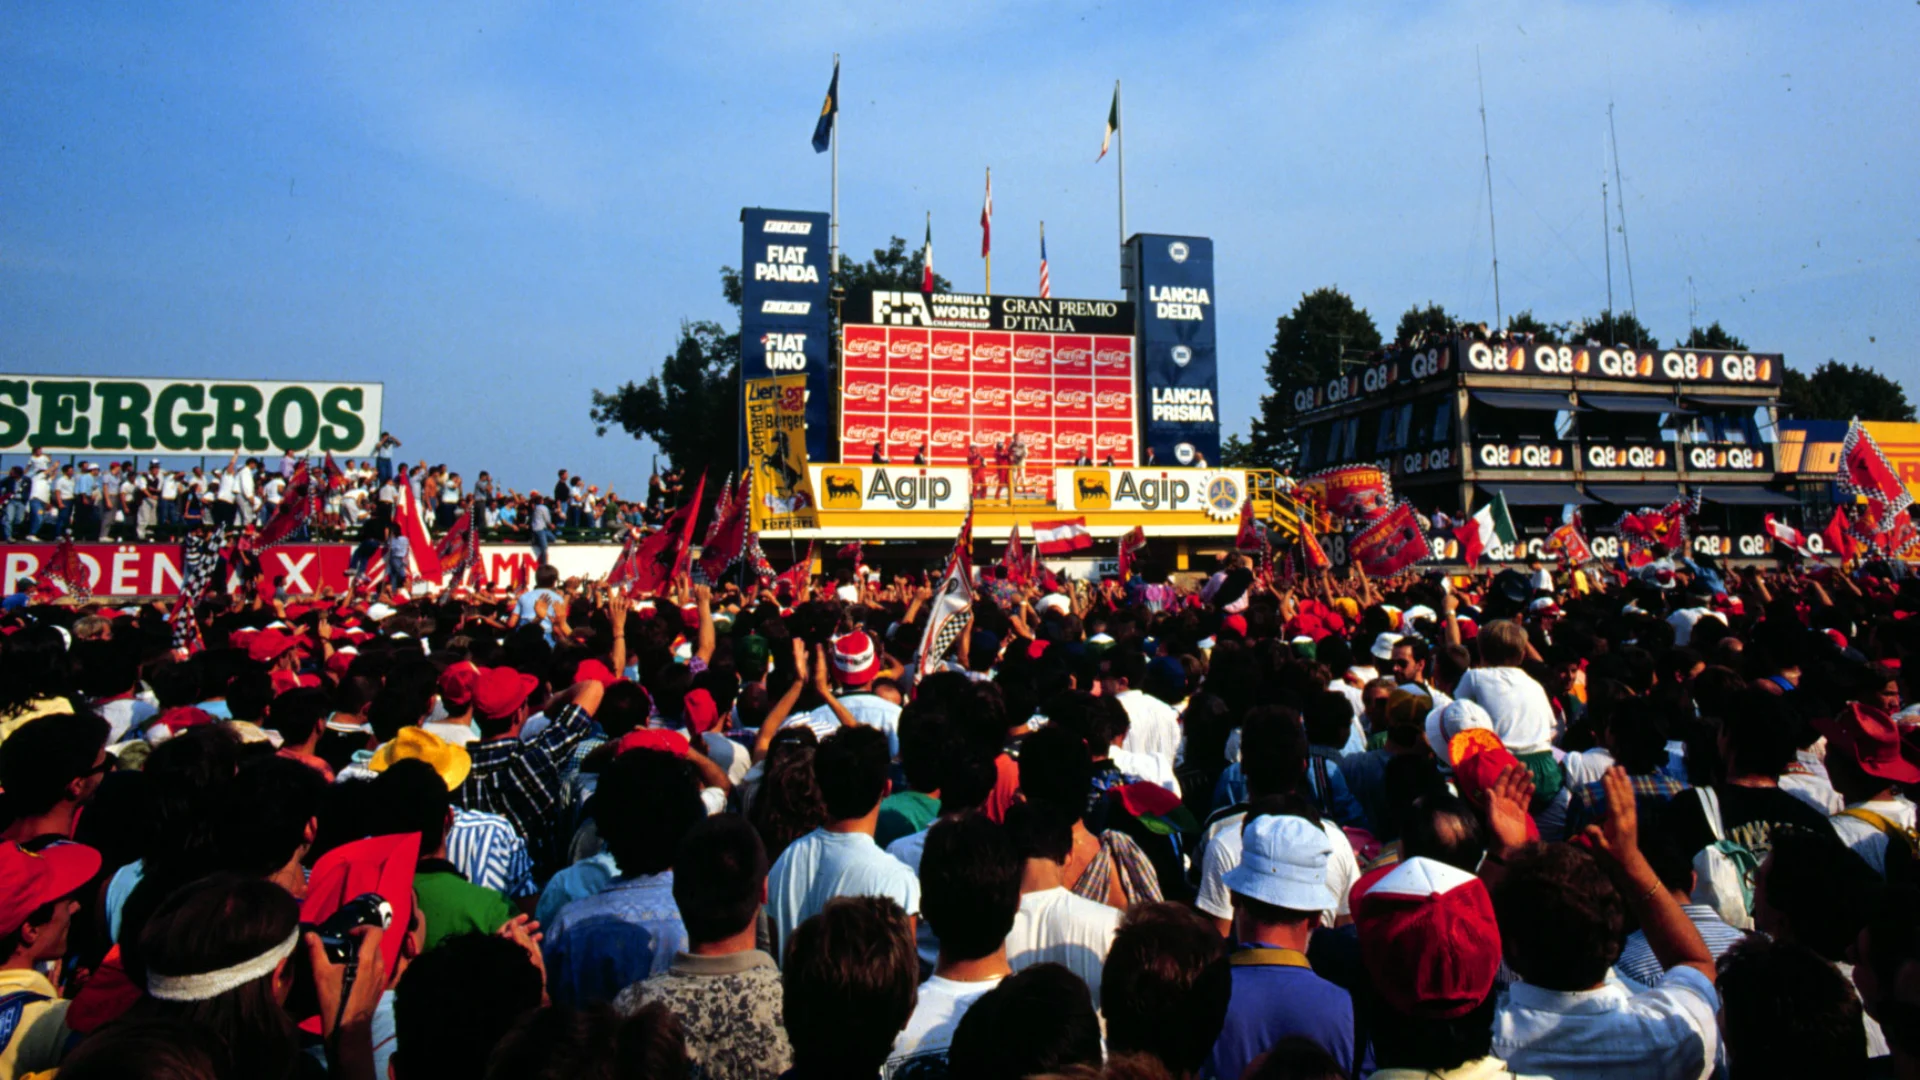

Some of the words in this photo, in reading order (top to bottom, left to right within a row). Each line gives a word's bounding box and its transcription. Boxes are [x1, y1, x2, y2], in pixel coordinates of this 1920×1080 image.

[767, 245, 808, 263] FIAT
[755, 263, 819, 283] PANDA
[932, 294, 983, 306] FORMULA
[985, 294, 991, 305] 1
[1150, 285, 1210, 304] LANCIA
[934, 305, 991, 320] WORLD
[1003, 298, 1052, 315] GRAN
[1059, 302, 1117, 317] PREMIO
[1157, 303, 1203, 320] DELTA
[932, 320, 991, 329] CHAMPIONSHIP
[765, 333, 807, 351] FIAT
[765, 352, 807, 370] UNO
[1412, 348, 1438, 378] Q8
[1468, 342, 1508, 371] Q8
[1535, 346, 1574, 373] Q8
[1599, 349, 1638, 376] Q8
[1662, 352, 1698, 379] Q8
[1364, 364, 1387, 392] Q8
[1722, 354, 1756, 381] Q8
[1152, 387, 1213, 404] LANCIA
[1294, 387, 1314, 412] Q8
[1328, 376, 1349, 402] Q8
[0, 381, 365, 453] SERGROS
[766, 414, 804, 431] Berger
[1153, 405, 1214, 422] PRISMA
[1404, 452, 1422, 474] Q8
[1429, 448, 1450, 470] Q8
[1480, 444, 1510, 466] Q8
[1523, 444, 1552, 466] Q8
[1588, 445, 1617, 467] Q8
[1628, 446, 1656, 467] Q8
[1690, 447, 1716, 468] Q8
[1728, 448, 1754, 469] Q8
[867, 468, 951, 509] Agip
[1115, 471, 1190, 510] Agip
[1591, 536, 1618, 558] Q8
[1694, 536, 1720, 556] Q8
[1739, 535, 1764, 556] Q8
